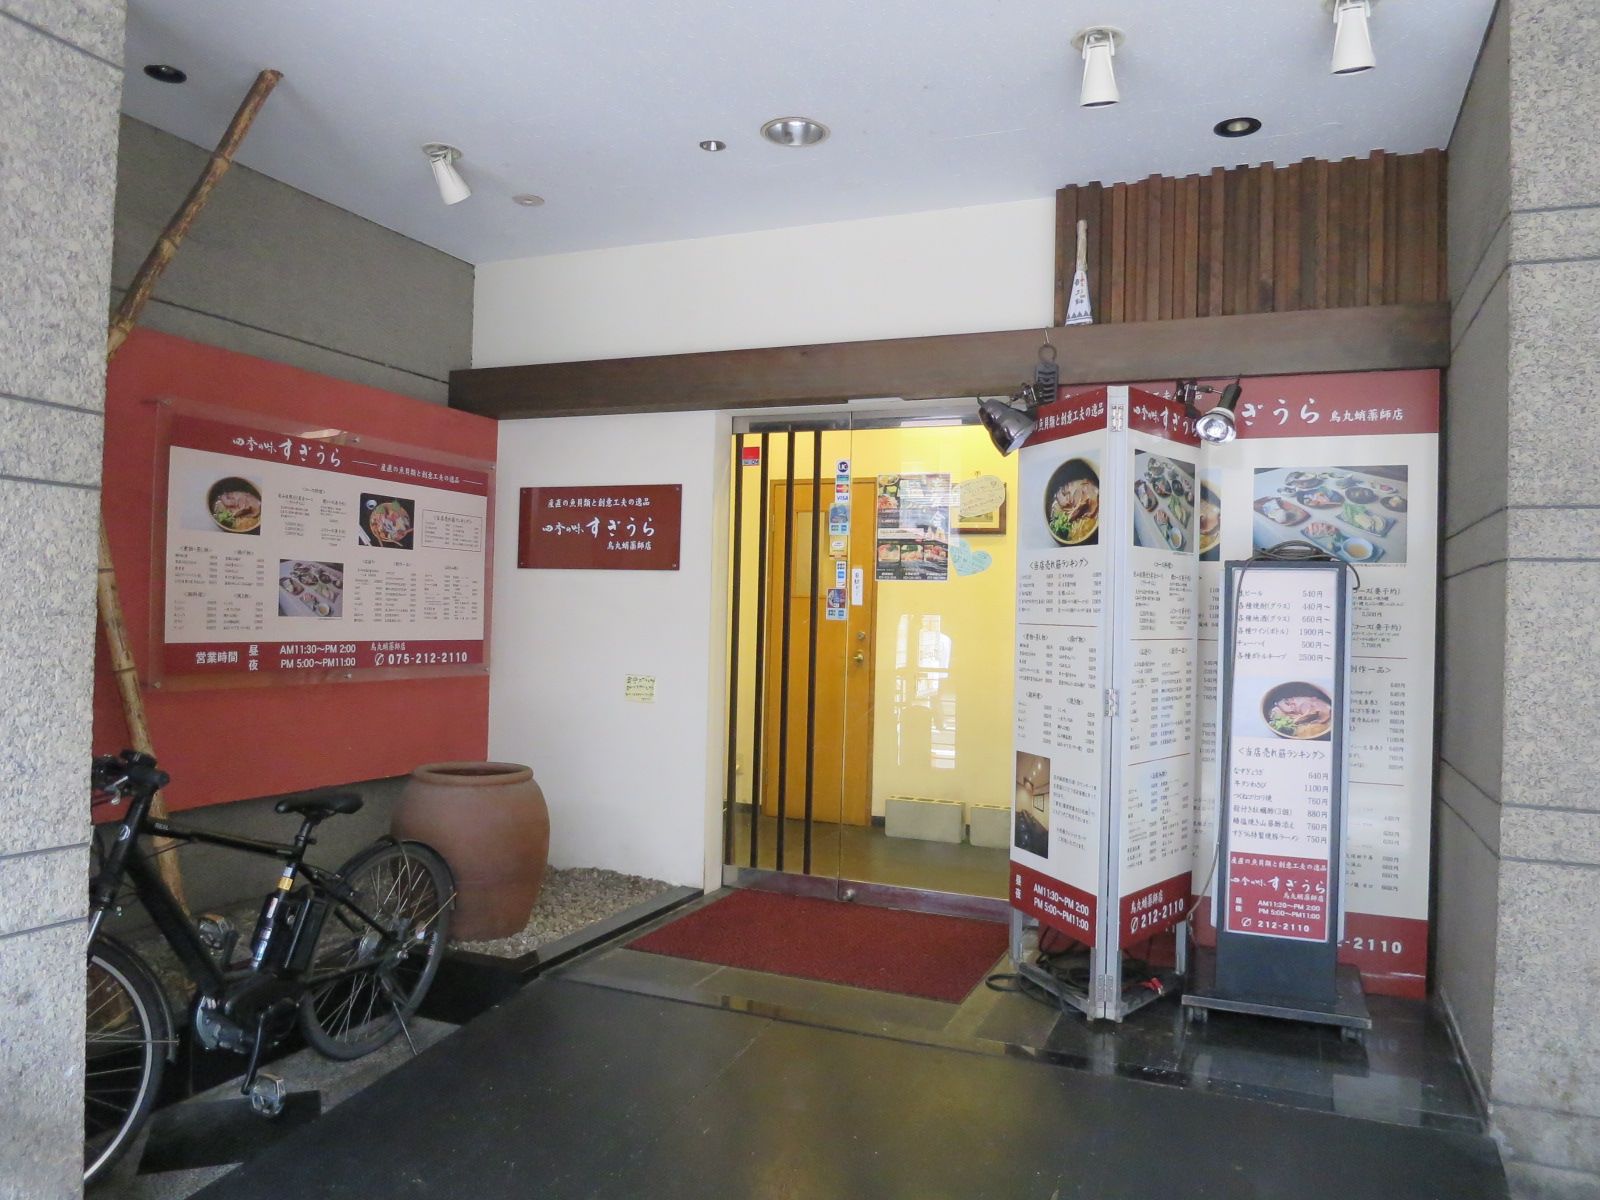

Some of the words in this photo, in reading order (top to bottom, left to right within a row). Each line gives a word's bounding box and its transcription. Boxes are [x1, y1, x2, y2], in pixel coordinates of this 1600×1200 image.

[1329, 408, 1404, 422] 烏丸蛸薬師店
[547, 498, 651, 508] 産直の魚貝類と創意工夫の逸品
[607, 540, 652, 550] 烏丸蛸薬師店
[196, 651, 238, 664] 営業時間
[249, 644, 259, 656] 昼
[339, 644, 356, 654] 2:00
[388, 652, 468, 664] 075-212-2110
[248, 660, 259, 671] 夜
[280, 658, 294, 669] PM
[1014, 888, 1022, 900] 夜
[1034, 897, 1043, 910] PM
[1076, 902, 1089, 916] 2:00
[1140, 898, 1184, 928] 212-2110
[1306, 904, 1320, 912] 2:00
[1258, 920, 1310, 932] 212-2110
[1338, 937, 1402, 954] -2110
